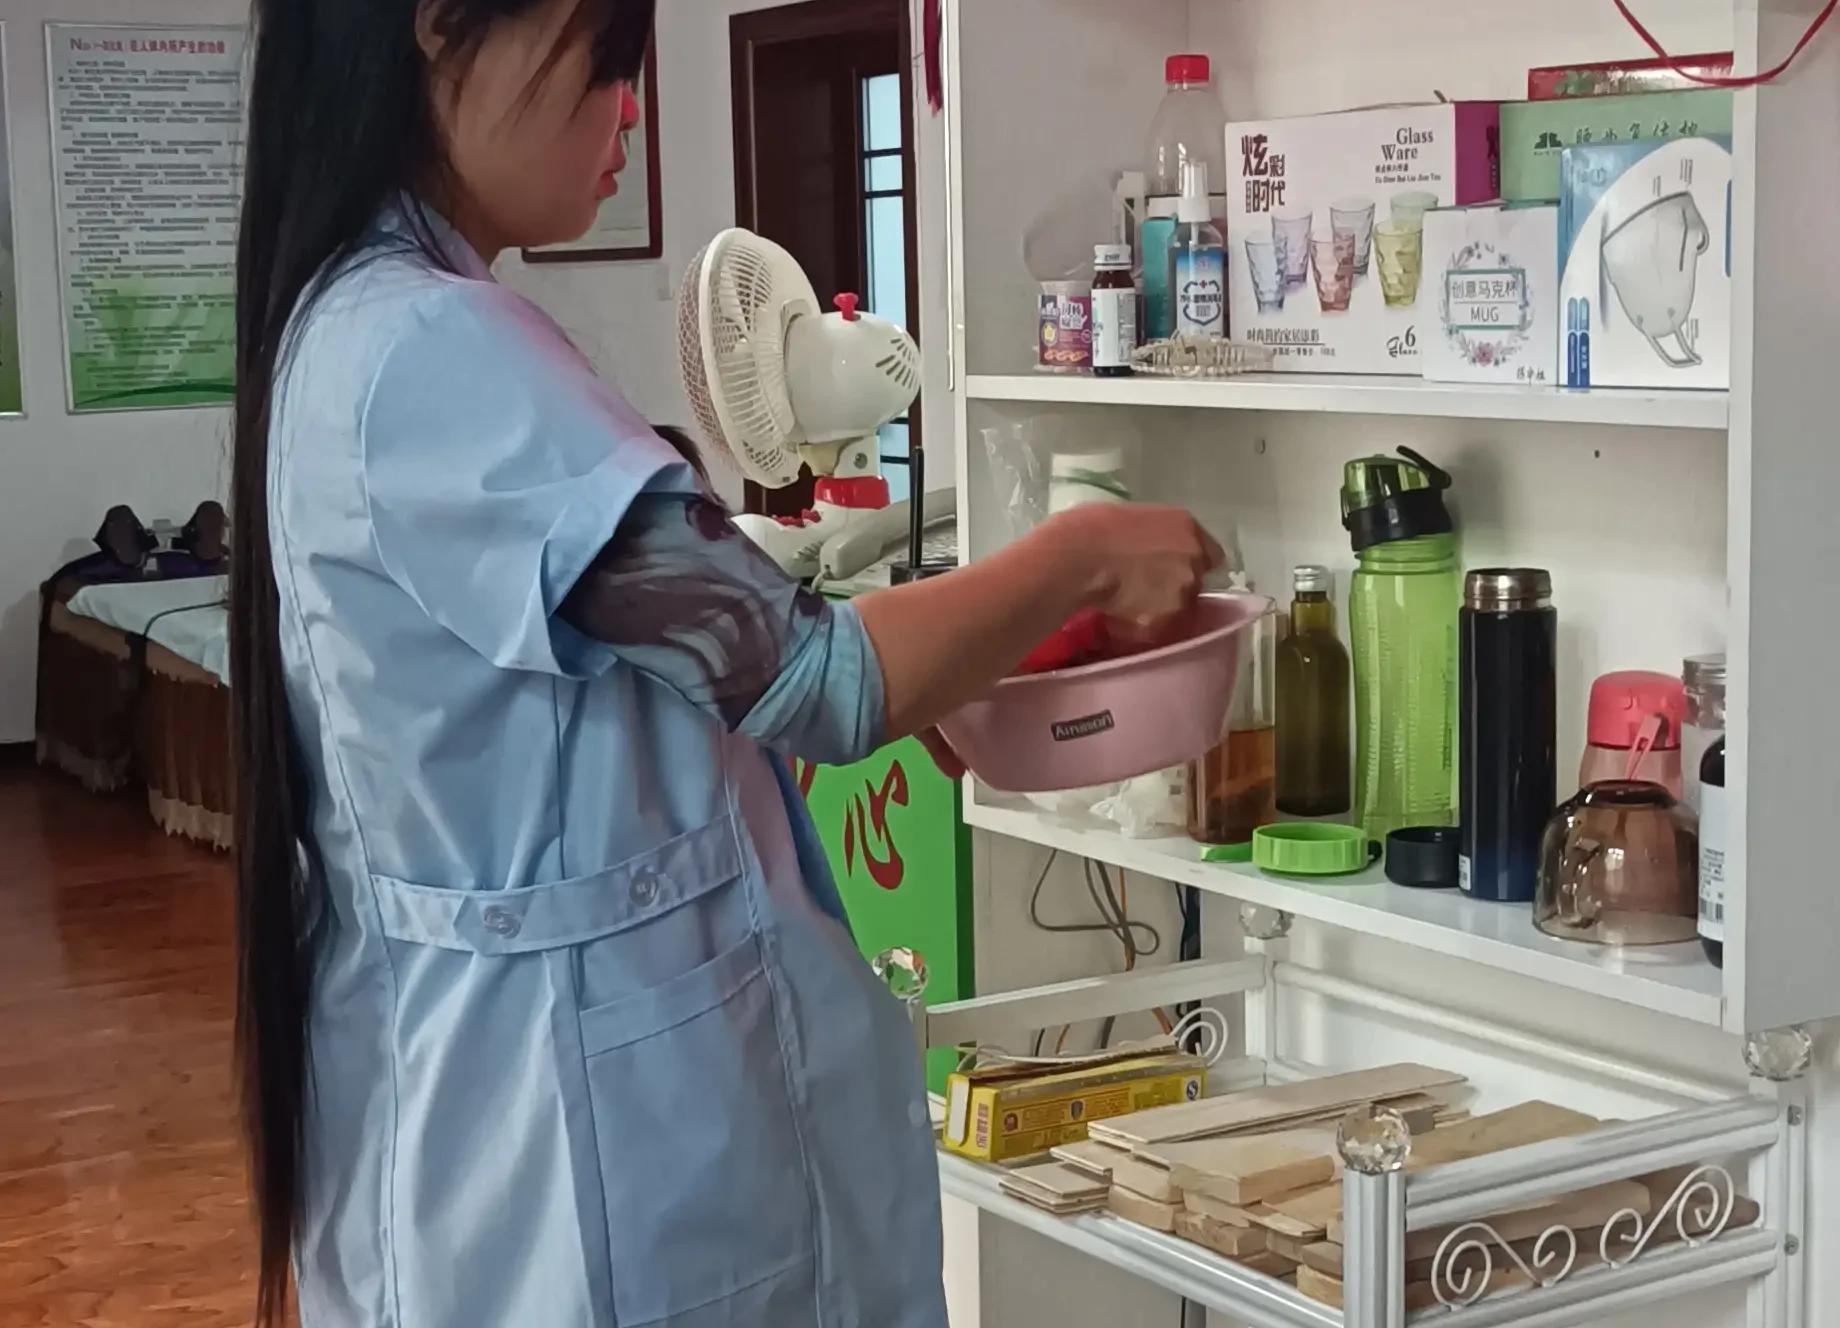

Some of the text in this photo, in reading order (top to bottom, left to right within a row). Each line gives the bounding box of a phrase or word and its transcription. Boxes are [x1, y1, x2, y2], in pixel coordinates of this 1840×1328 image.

[1396, 127, 1434, 145] Glass
[1381, 144, 1418, 161] Ware
[1452, 280, 1517, 299] 创意马克杯
[1470, 306, 1500, 322] MUG
[1405, 324, 1416, 347] 6
[844, 759, 909, 891] 心
